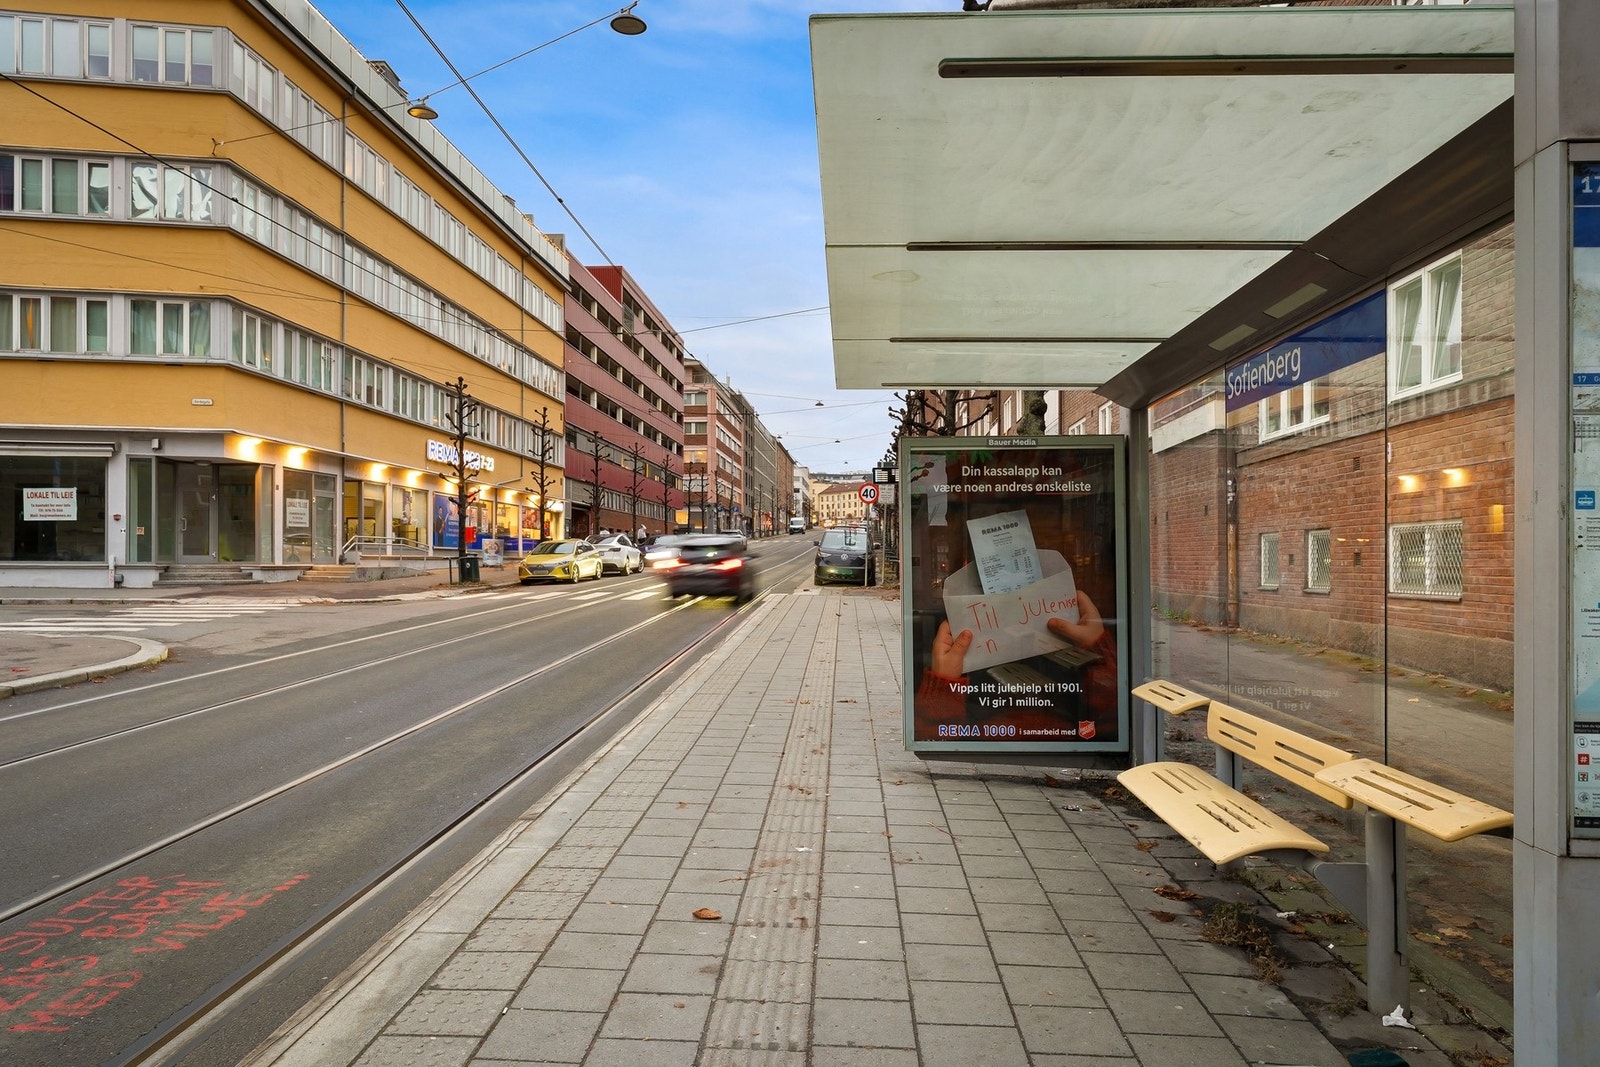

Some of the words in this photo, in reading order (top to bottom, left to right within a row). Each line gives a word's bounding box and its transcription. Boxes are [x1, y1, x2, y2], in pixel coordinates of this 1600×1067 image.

[1227, 347, 1301, 399] Sofienberg
[1577, 375, 1587, 383] 17
[428, 440, 459, 464] REMA
[962, 465, 981, 476] Din
[983, 465, 1040, 478] kassalapp
[1041, 465, 1062, 476] kan
[933, 484, 962, 492] være
[964, 484, 992, 492] noen
[994, 481, 1033, 492] andres
[1035, 480, 1092, 492] ønskeliste
[862, 488, 876, 499] 40
[981, 526, 1002, 535] REMA
[967, 602, 999, 632] Til
[950, 683, 978, 694] Vipps
[981, 682, 995, 693] litt
[997, 682, 1041, 694] julehjelp
[1044, 682, 1055, 693] til
[1058, 683, 1083, 693] 1901.
[979, 697, 990, 706] Vi
[992, 697, 1006, 708] gir
[1009, 697, 1013, 706] 1
[1016, 697, 1054, 706] million.
[938, 725, 980, 736] REMA
[984, 725, 1016, 736] 1000
[1023, 728, 1060, 736] samarbeid
[1060, 728, 1076, 736] med
[7, 969, 143, 1033] MED
